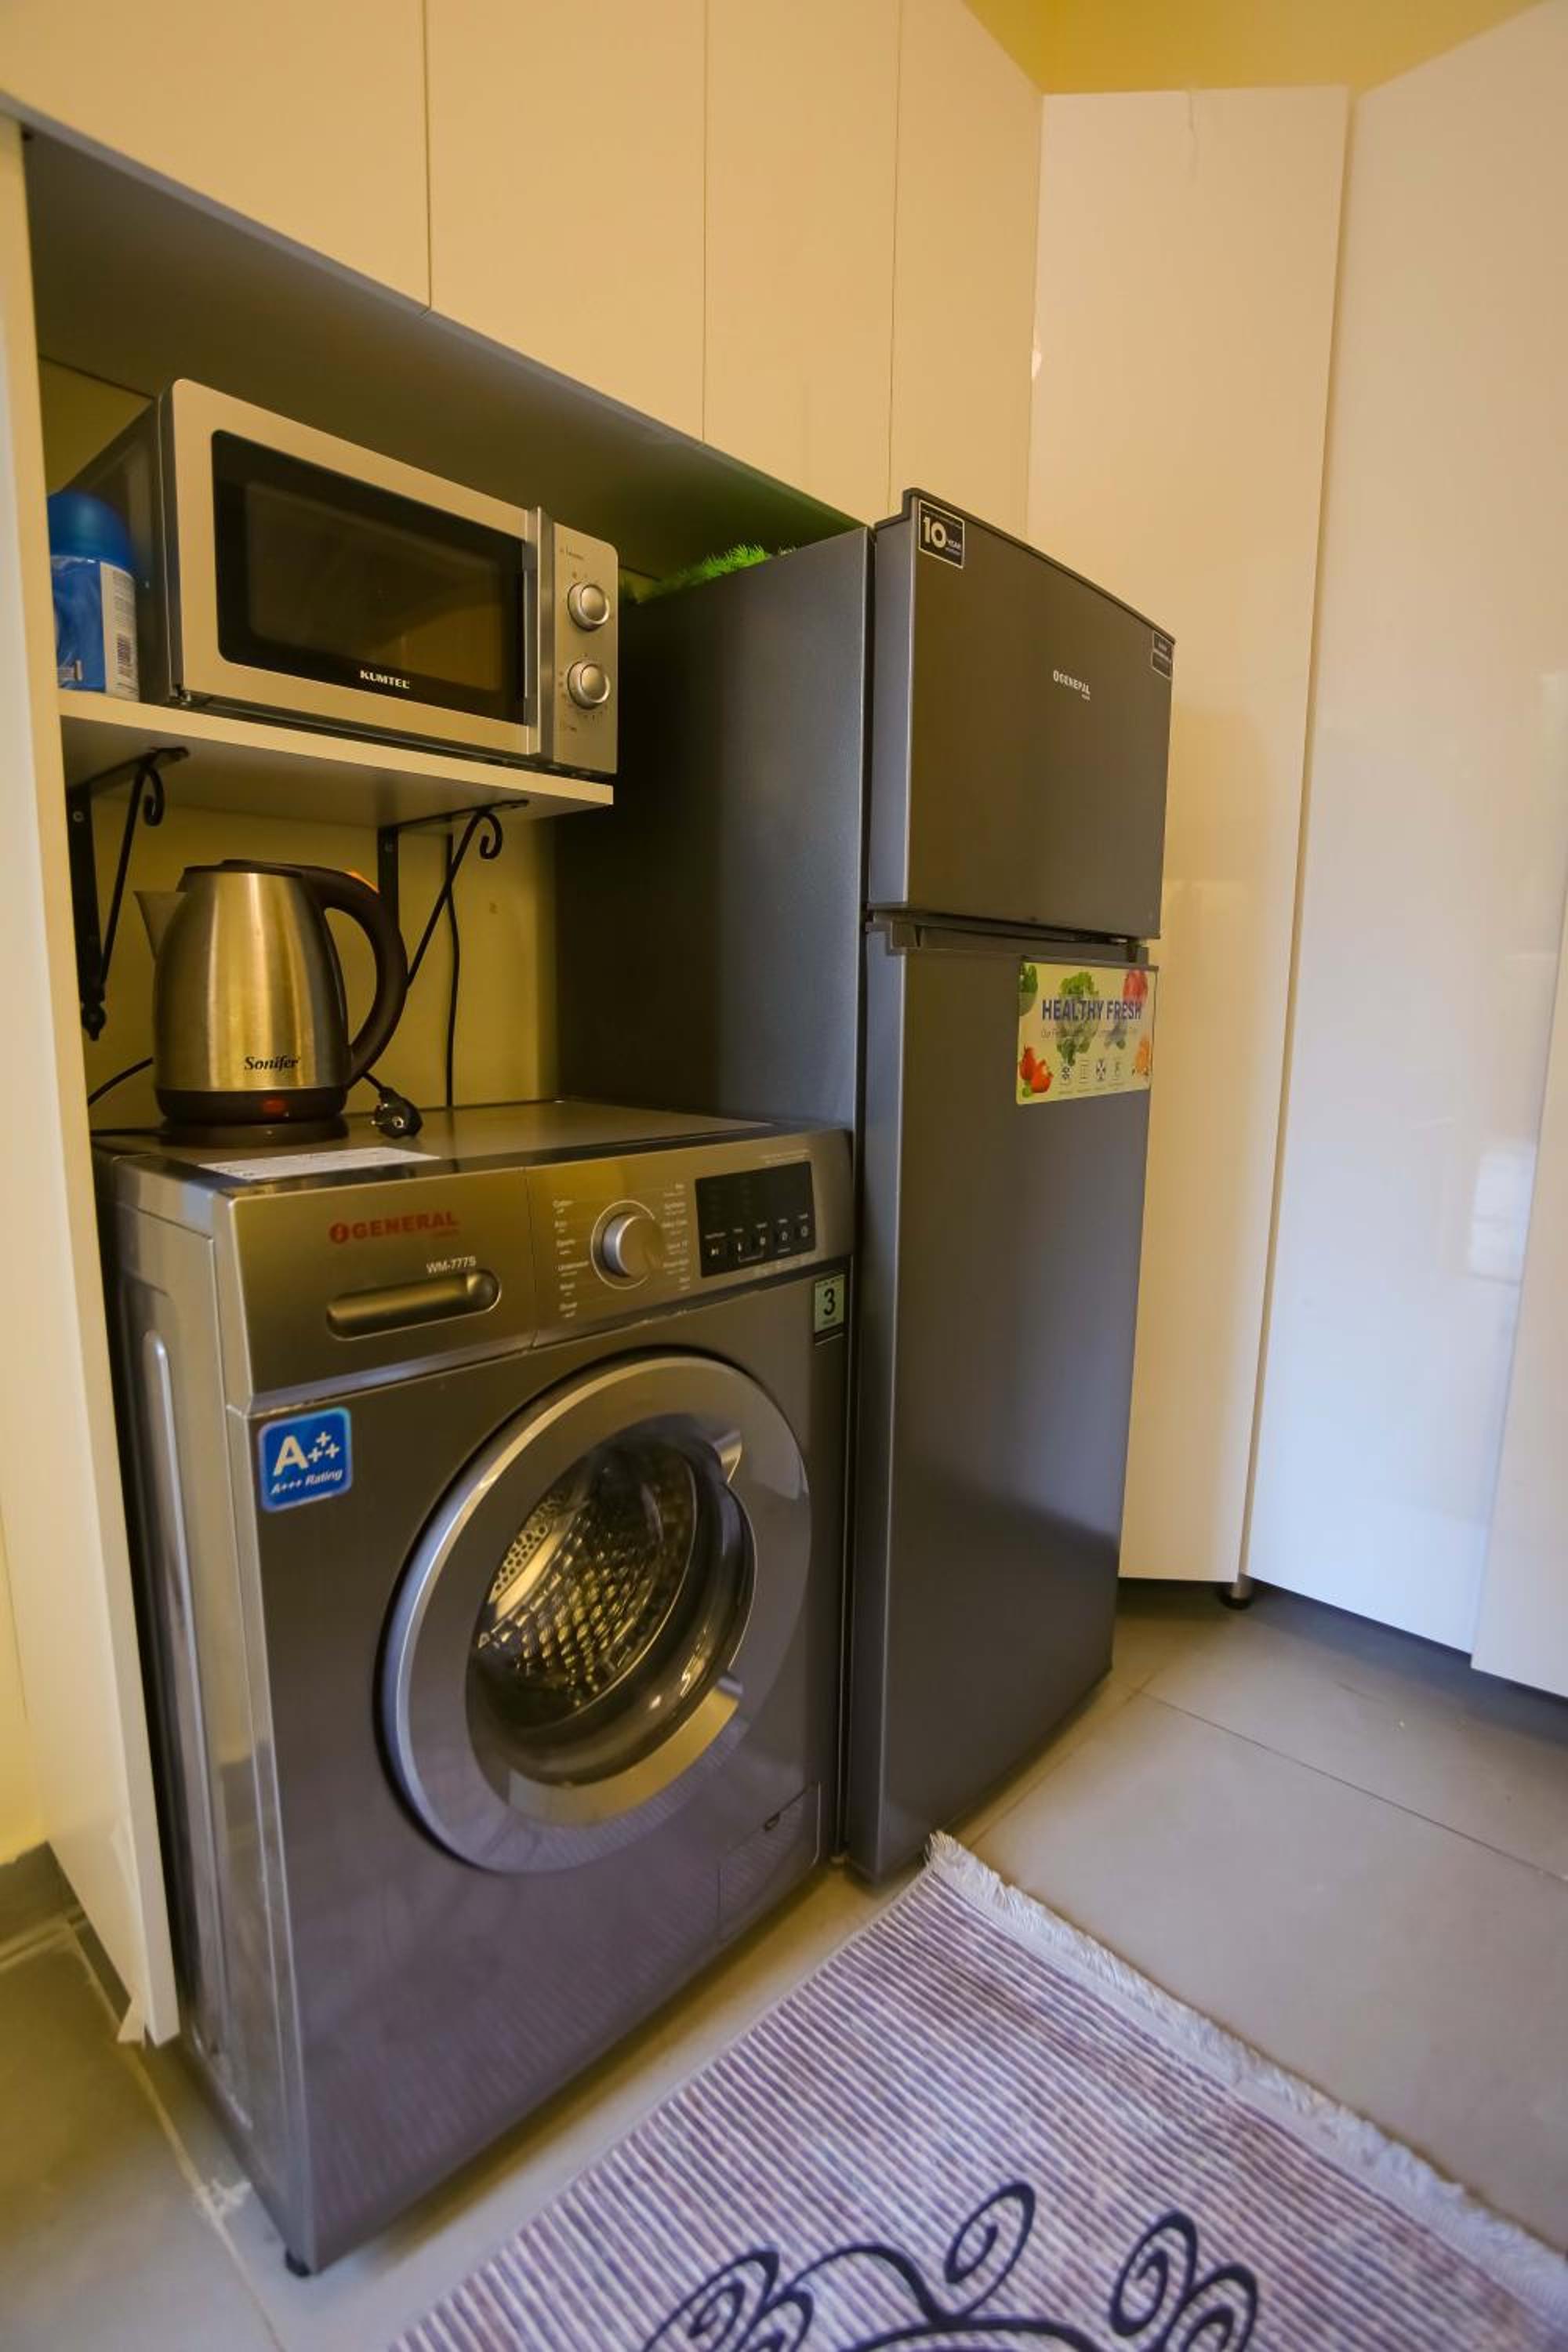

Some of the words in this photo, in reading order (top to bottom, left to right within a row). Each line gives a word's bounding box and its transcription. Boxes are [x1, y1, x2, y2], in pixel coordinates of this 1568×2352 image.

[923, 516, 947, 549] 10
[359, 669, 410, 689] KUMTEL
[1042, 999, 1104, 1022] HEALTHY
[1106, 1000, 1142, 1020] FRESH
[244, 1055, 299, 1072] Sonifer
[823, 1287, 836, 1316] 3
[305, 1468, 343, 1486] Rating
